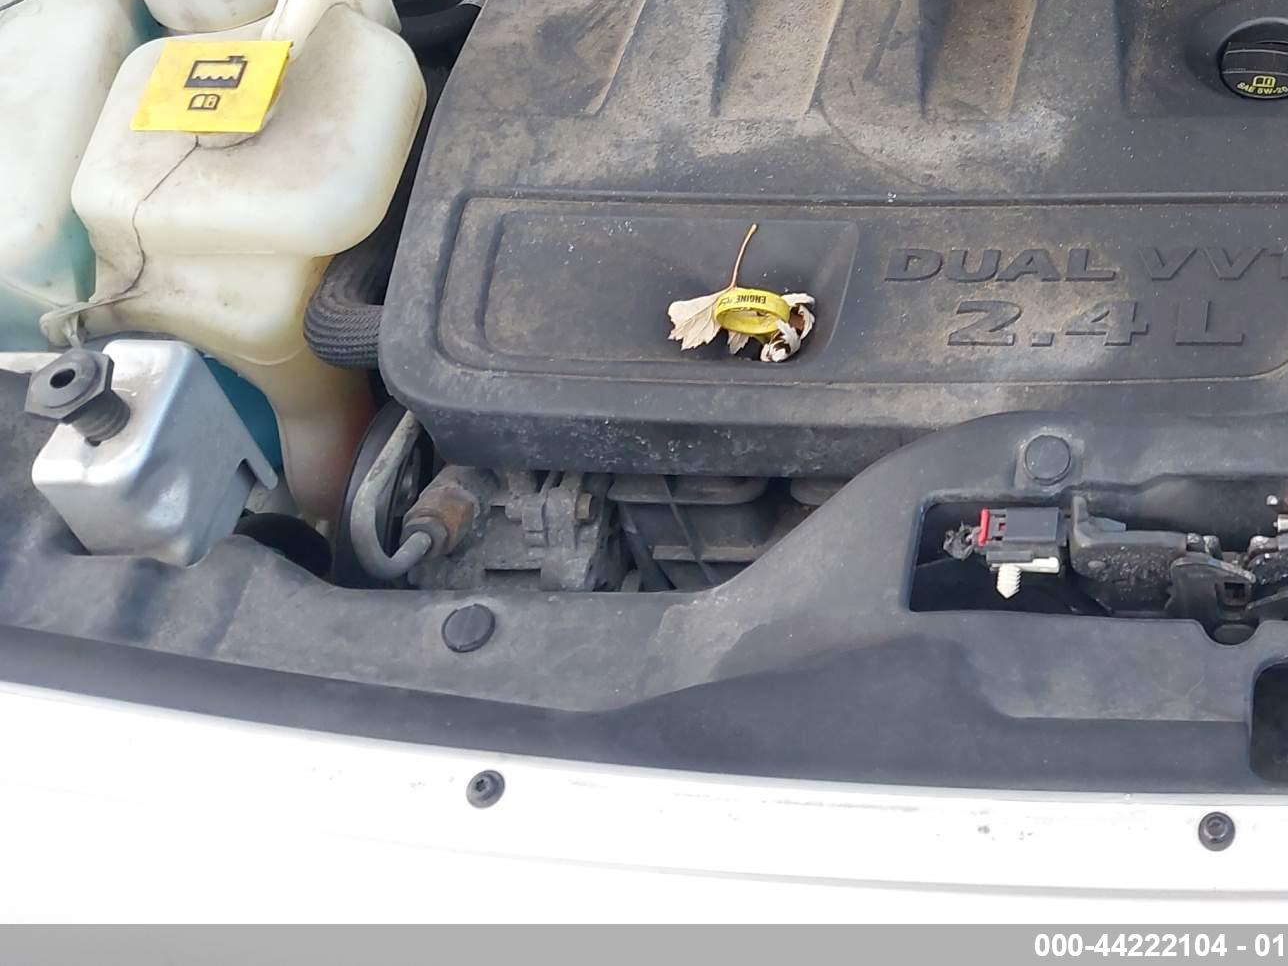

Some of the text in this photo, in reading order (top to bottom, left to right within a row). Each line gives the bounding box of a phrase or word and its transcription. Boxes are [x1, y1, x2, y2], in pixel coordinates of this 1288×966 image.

[1236, 81, 1256, 94] SAE
[884, 247, 1117, 283] DUAL
[736, 294, 767, 305] ENGINE
